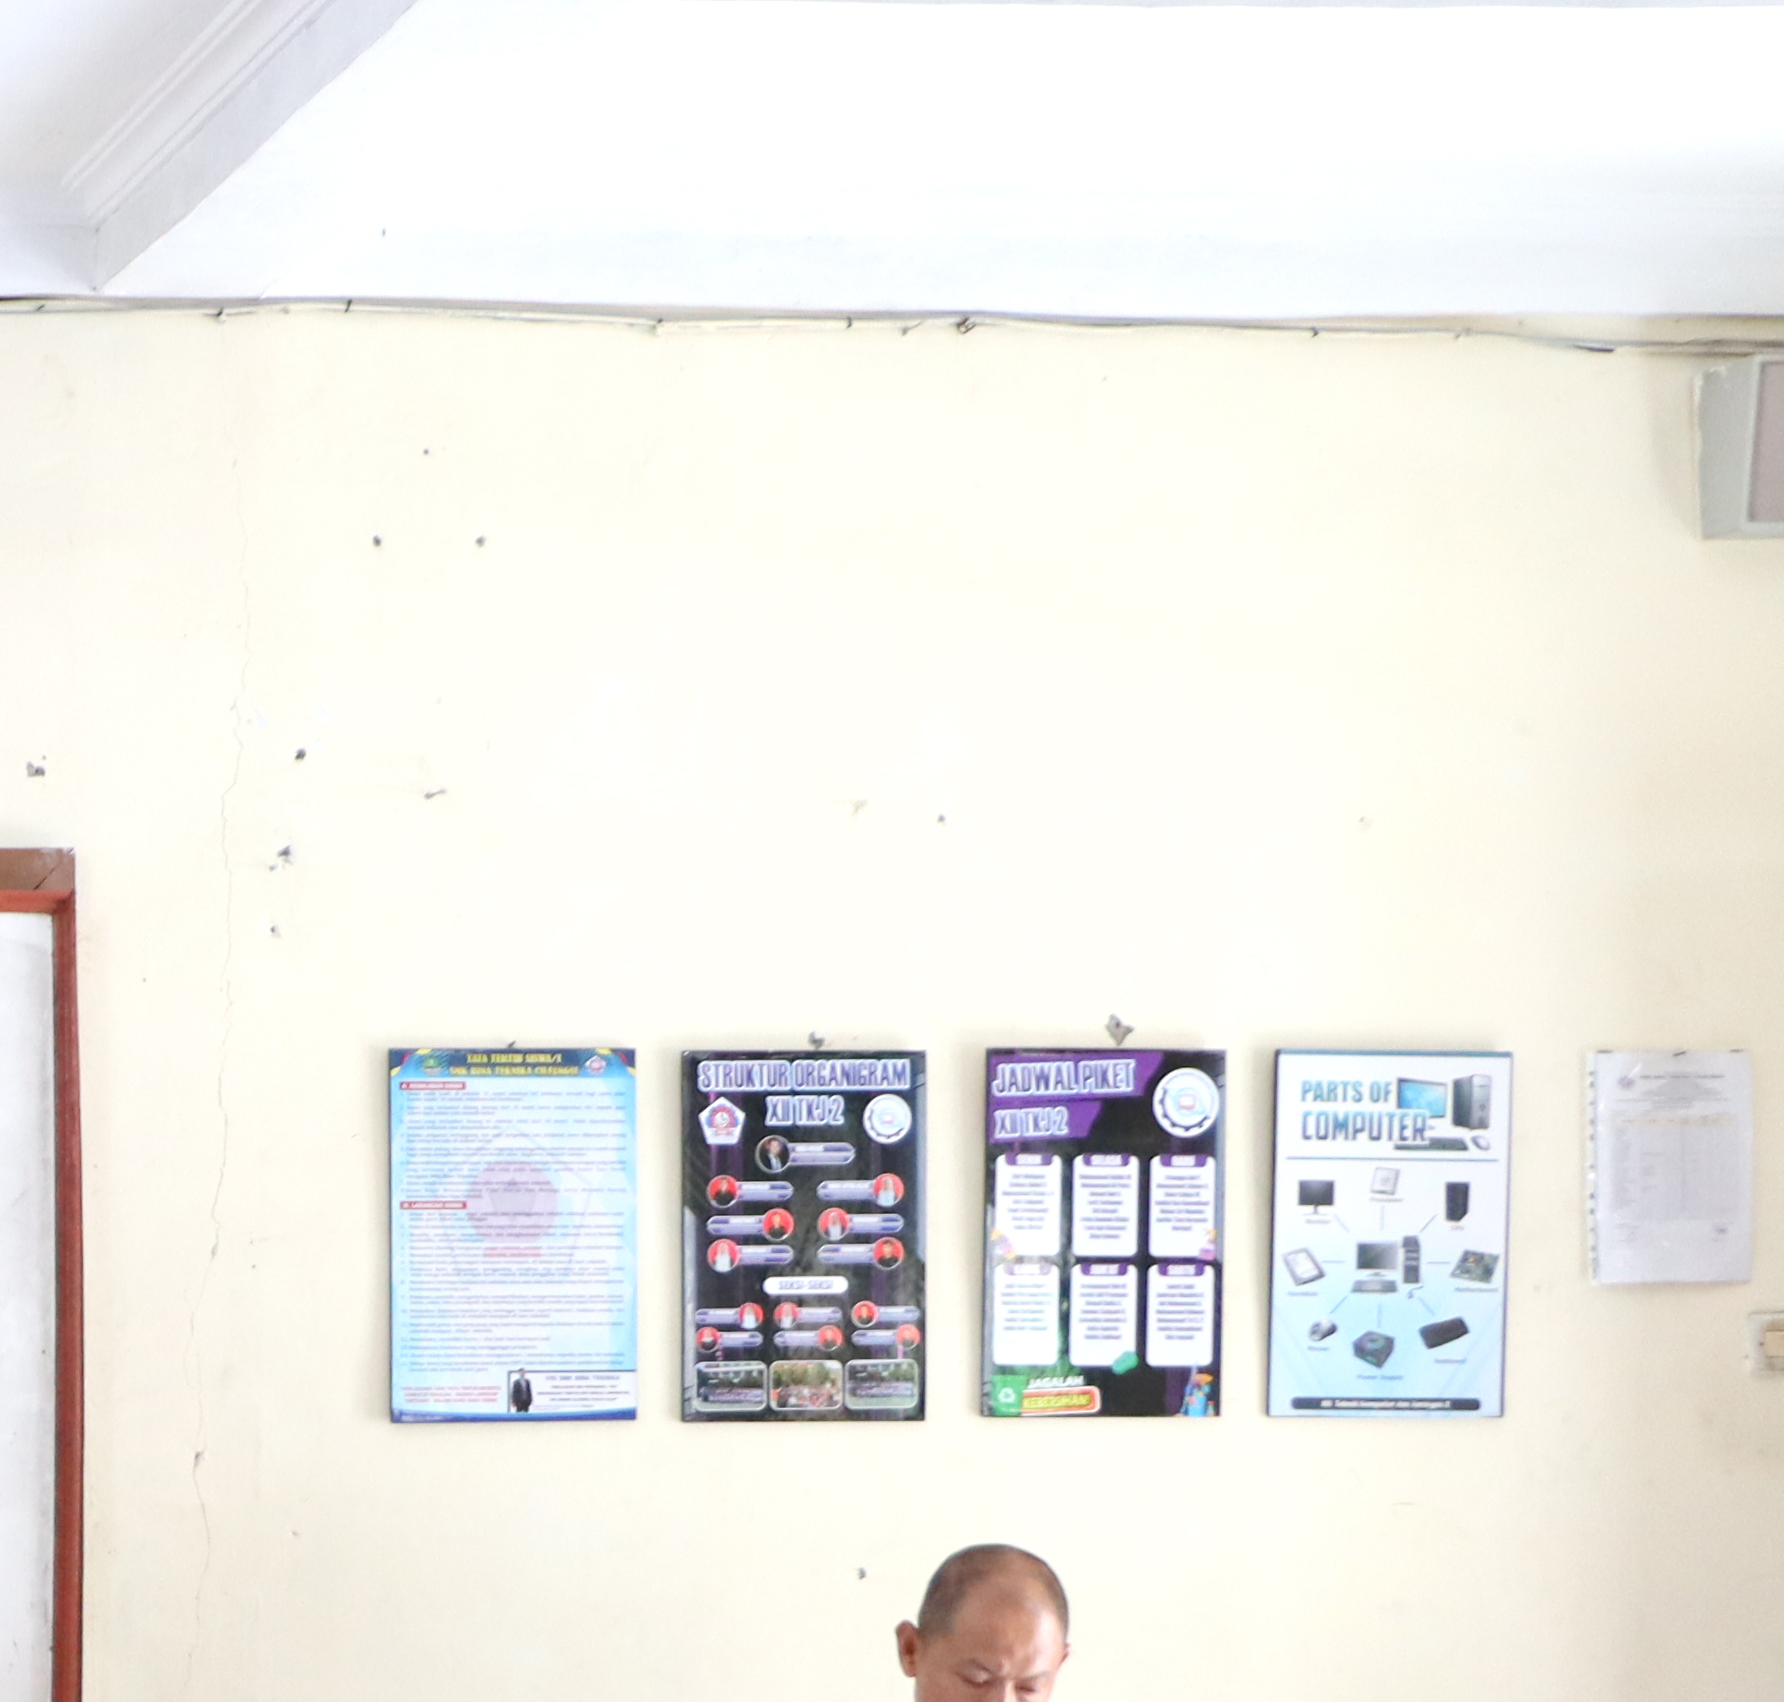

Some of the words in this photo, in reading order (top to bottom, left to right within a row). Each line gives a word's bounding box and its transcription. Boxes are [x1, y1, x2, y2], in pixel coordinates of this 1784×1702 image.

[698, 1061, 790, 1091] STRUKTUR
[992, 1061, 1077, 1097] JADWAL
[1078, 1059, 1136, 1094] PIKET
[1300, 1080, 1363, 1103] PARTS
[1370, 1081, 1393, 1103] OF
[1301, 1110, 1427, 1142] COMPUTER
